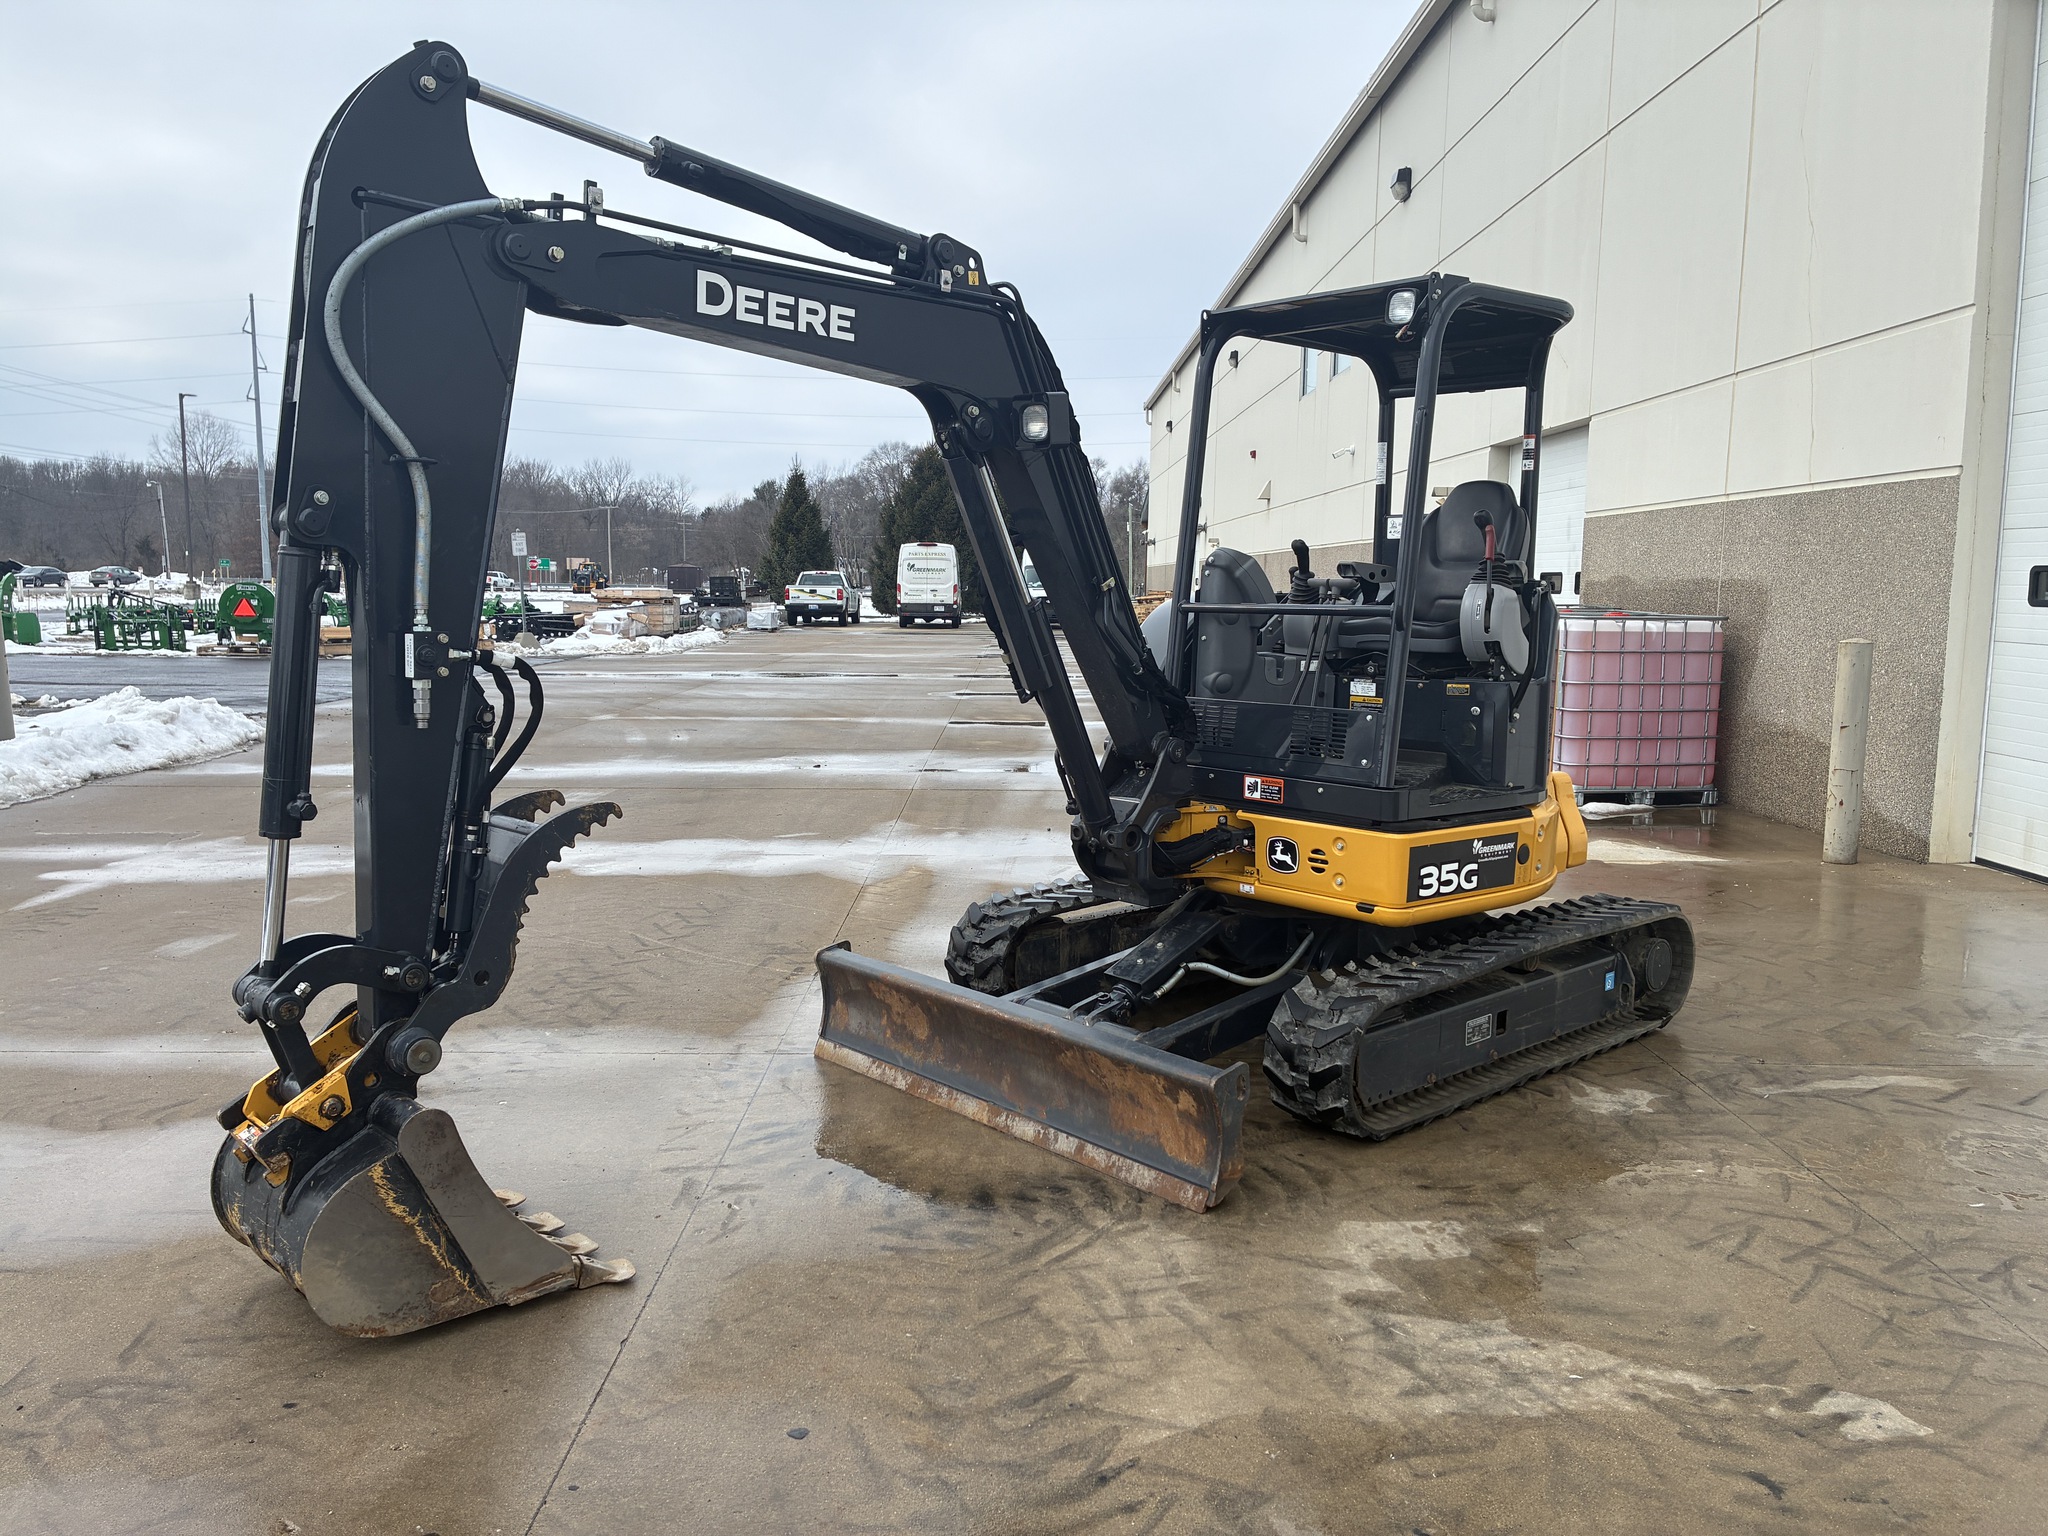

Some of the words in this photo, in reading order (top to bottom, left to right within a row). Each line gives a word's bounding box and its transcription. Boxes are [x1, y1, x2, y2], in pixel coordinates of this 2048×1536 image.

[697, 269, 856, 342] DEERE
[1478, 842, 1515, 854] GREENMARK
[1480, 849, 1512, 857] EQUIPMENT
[1418, 862, 1478, 897] 35G
